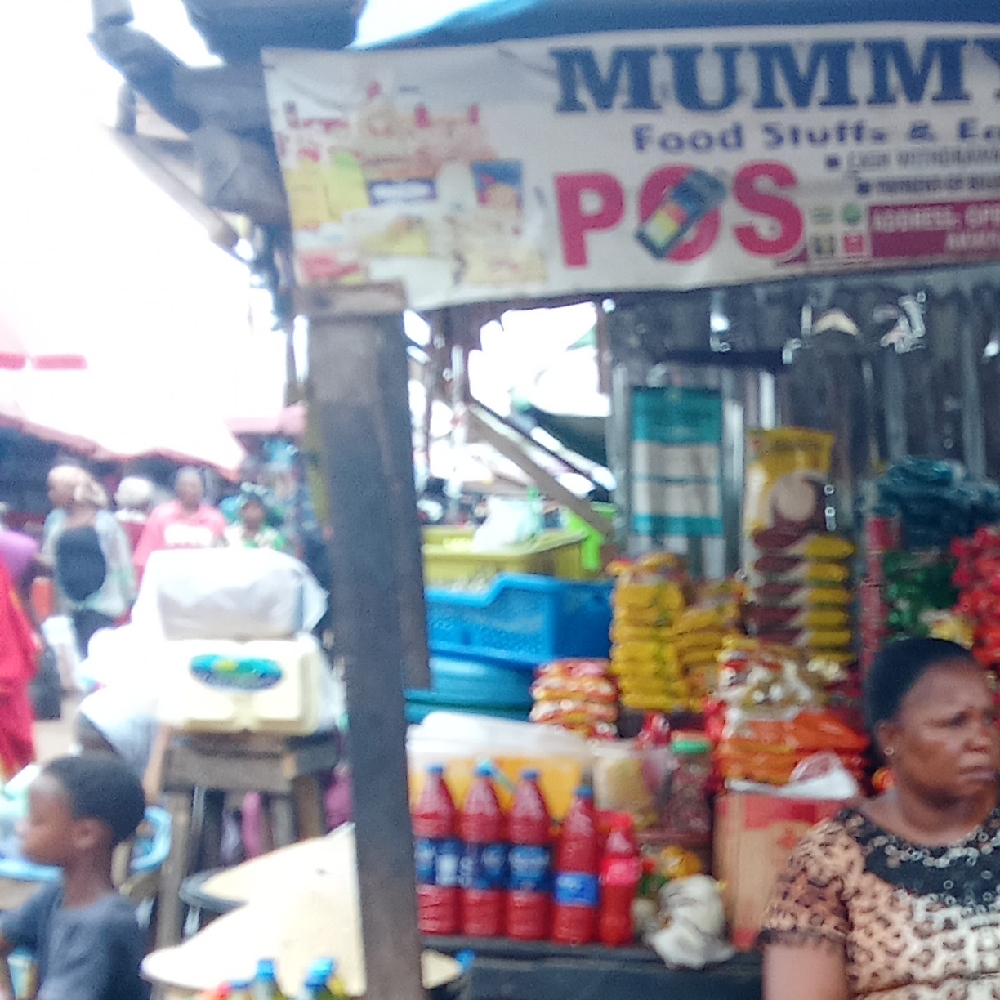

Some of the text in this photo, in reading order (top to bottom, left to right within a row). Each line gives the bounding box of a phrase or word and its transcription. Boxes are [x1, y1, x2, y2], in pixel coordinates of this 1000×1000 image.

[631, 122, 745, 154] Food
[761, 119, 888, 149] Stuffs
[908, 120, 936, 142] &
[553, 160, 806, 268] POS
